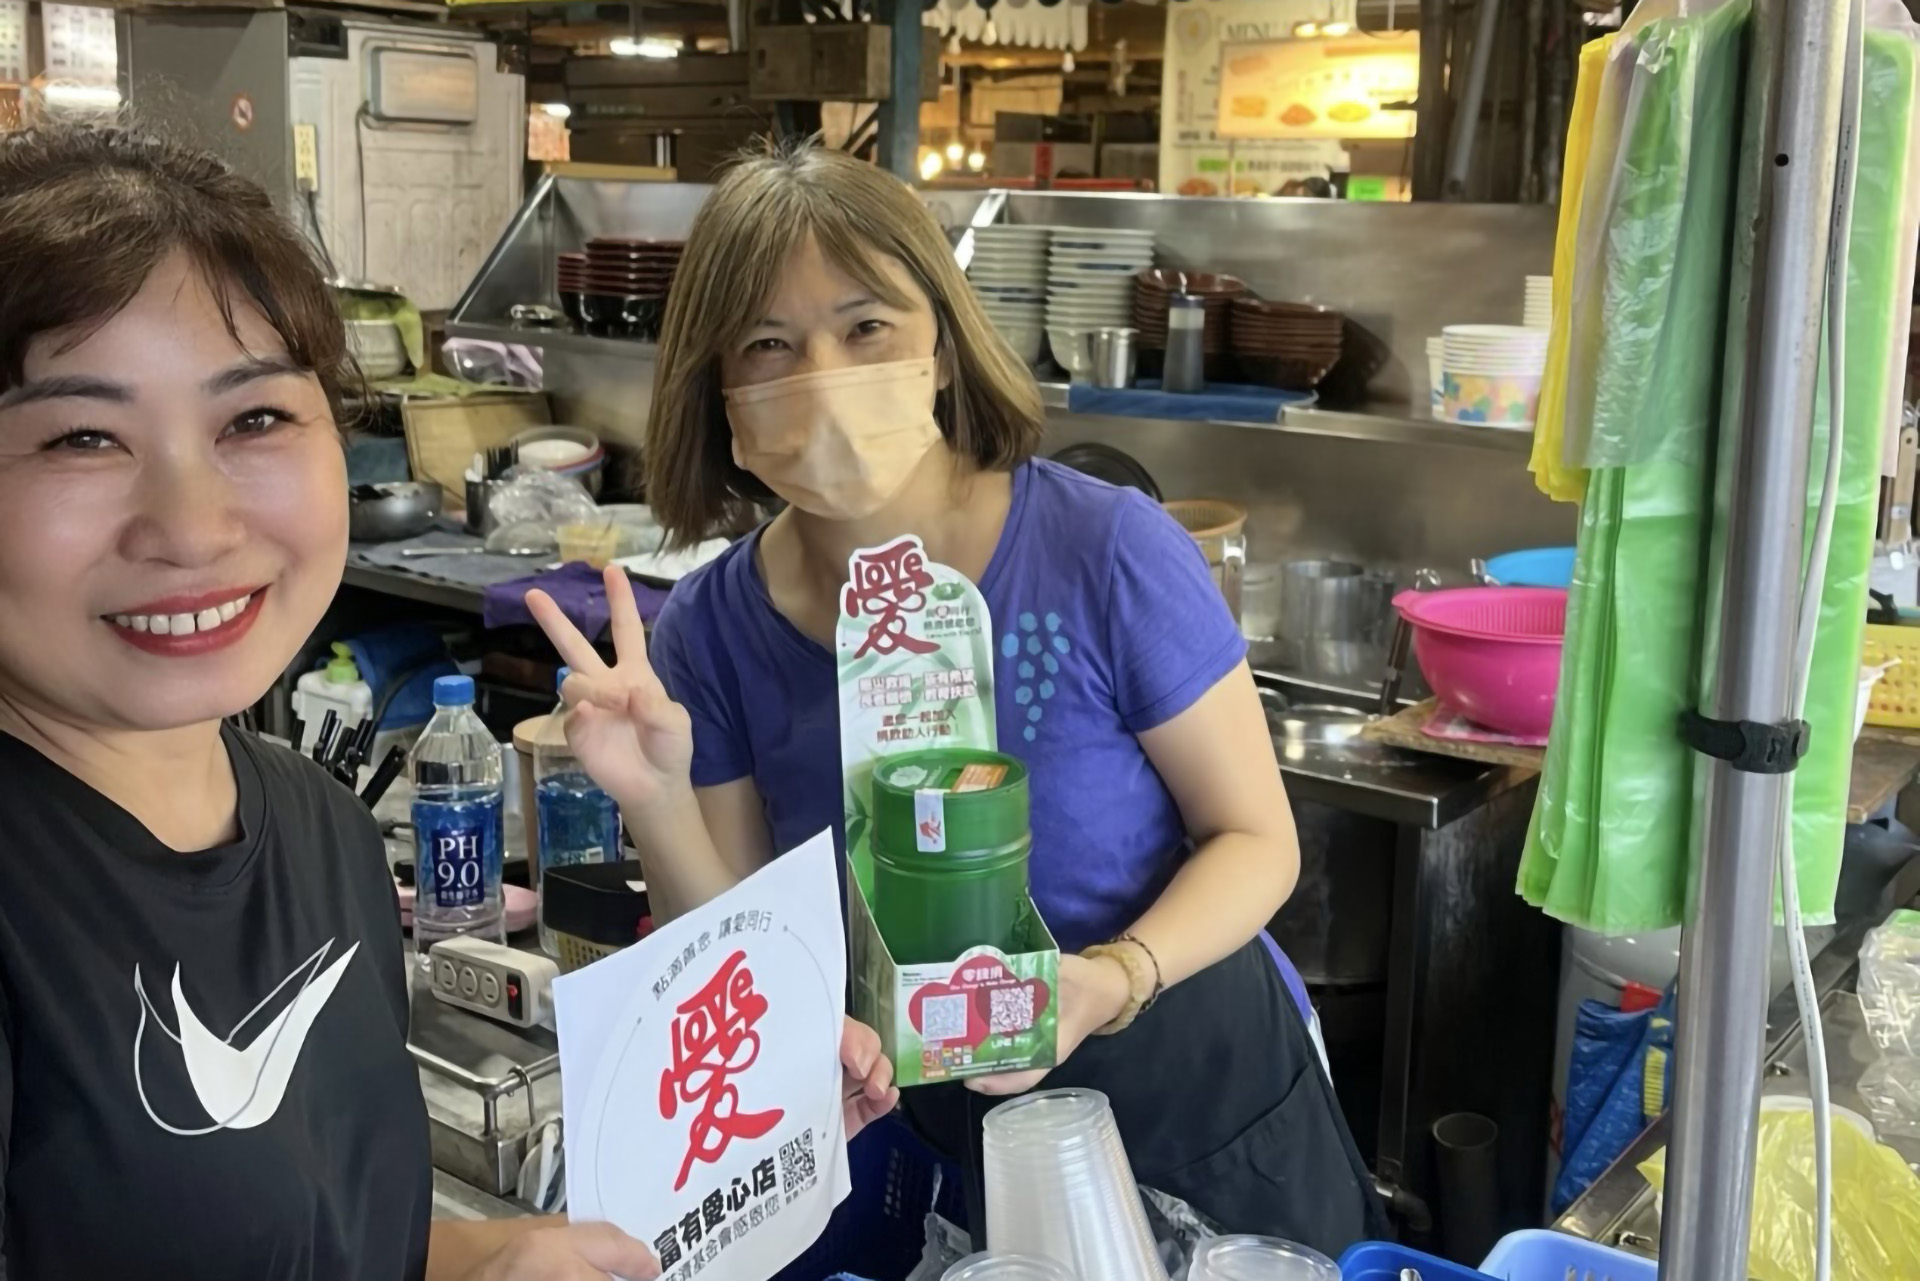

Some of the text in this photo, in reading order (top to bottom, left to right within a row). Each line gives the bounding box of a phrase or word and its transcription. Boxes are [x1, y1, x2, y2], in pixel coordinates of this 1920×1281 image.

[437, 860, 480, 889] 9.0
[438, 835, 478, 860] PH
[652, 1155, 777, 1273] 富有愛心店
[664, 1193, 781, 1281] 濟基金會感恩您
